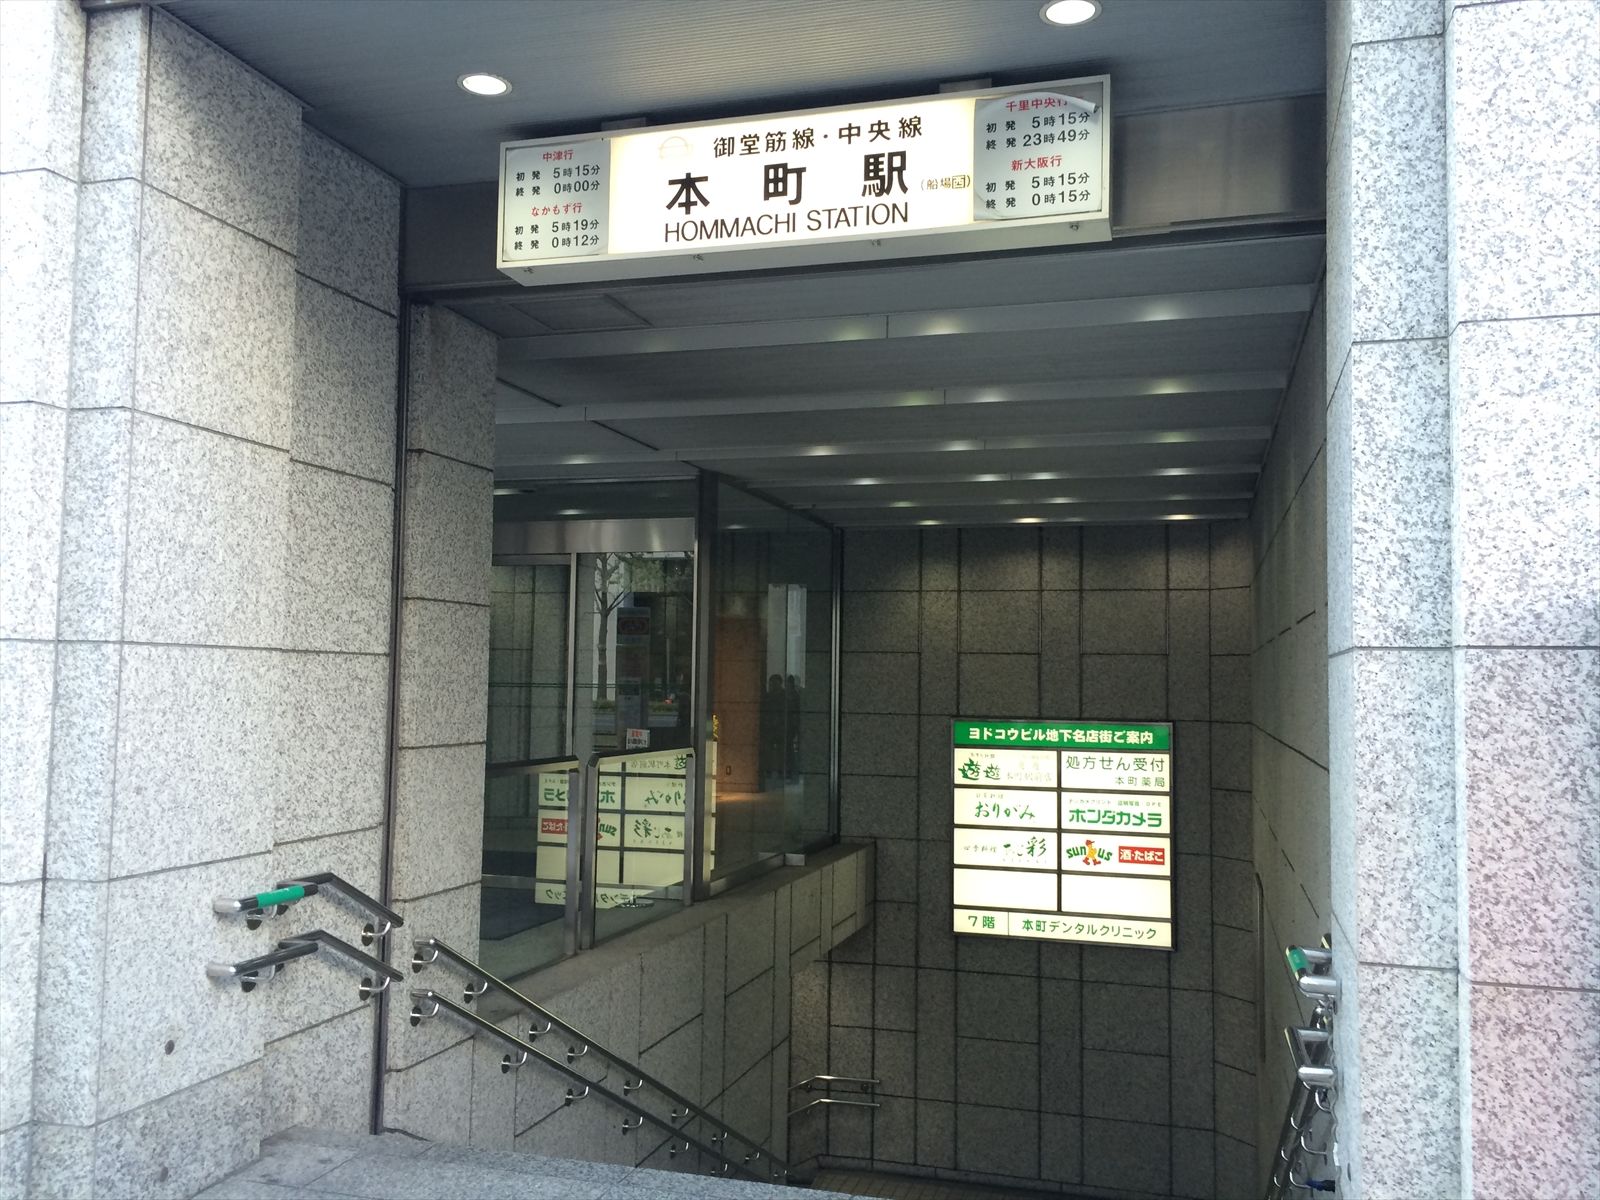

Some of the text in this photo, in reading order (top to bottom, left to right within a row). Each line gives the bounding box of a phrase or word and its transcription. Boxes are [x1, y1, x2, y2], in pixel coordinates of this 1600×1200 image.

[713, 116, 922, 158] 御堂筋線・中央線
[542, 149, 574, 162] 中津行
[1011, 155, 1063, 171] 新大阪行
[531, 202, 583, 216] なかもず行
[664, 202, 909, 243] HOMMACHI STATION
[968, 727, 1154, 745] ヨドコウビル地下名店街ご案内
[1066, 755, 1165, 773] 処方せん受付
[1115, 776, 1165, 787] 本町薬局
[1069, 809, 1163, 828] ホンダカメラ
[967, 915, 996, 929] 7階
[1022, 919, 1157, 940] 本町デンタルクリニック
